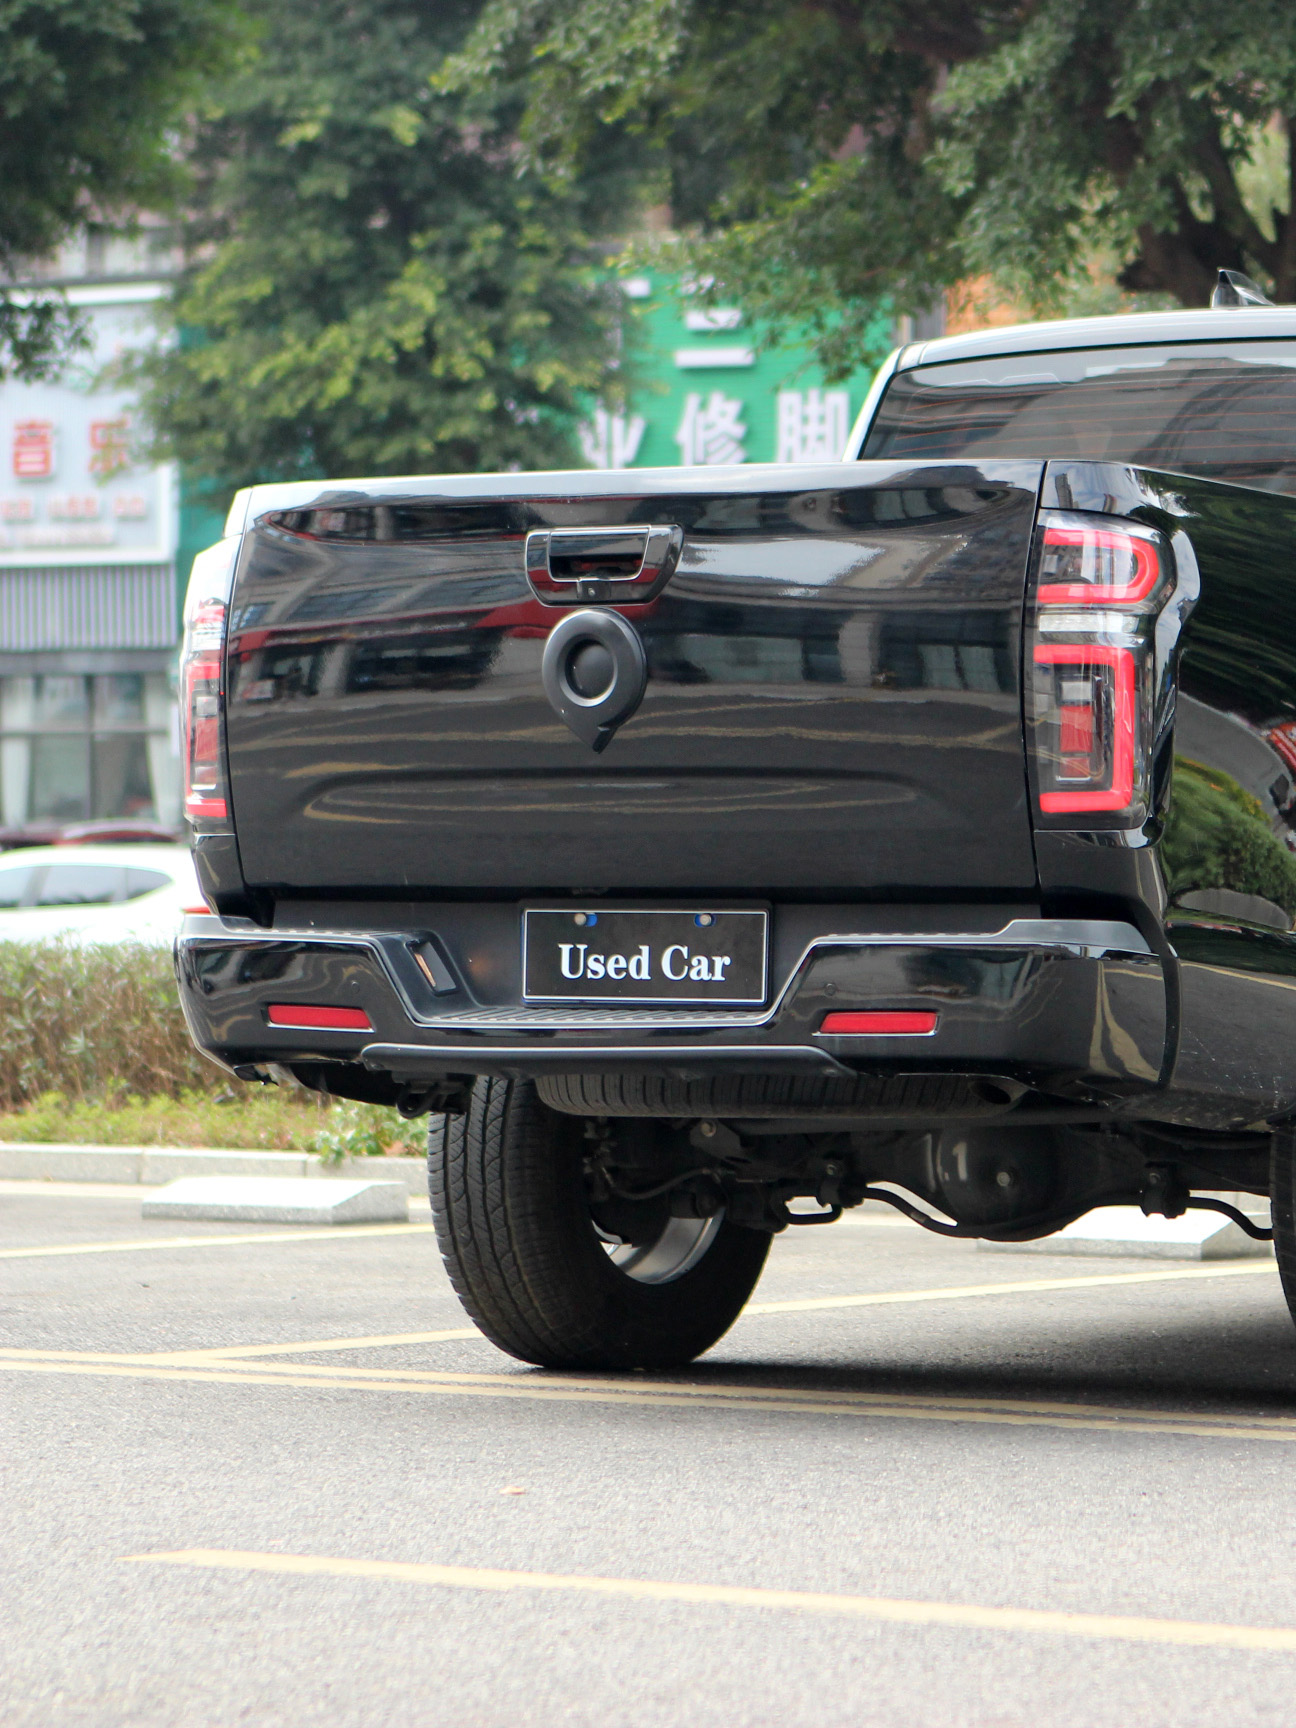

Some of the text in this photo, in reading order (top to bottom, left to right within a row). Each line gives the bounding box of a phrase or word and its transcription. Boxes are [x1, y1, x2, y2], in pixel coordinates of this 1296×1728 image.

[512, 388, 850, 468] 业修脚
[558, 943, 731, 981] Used Car
